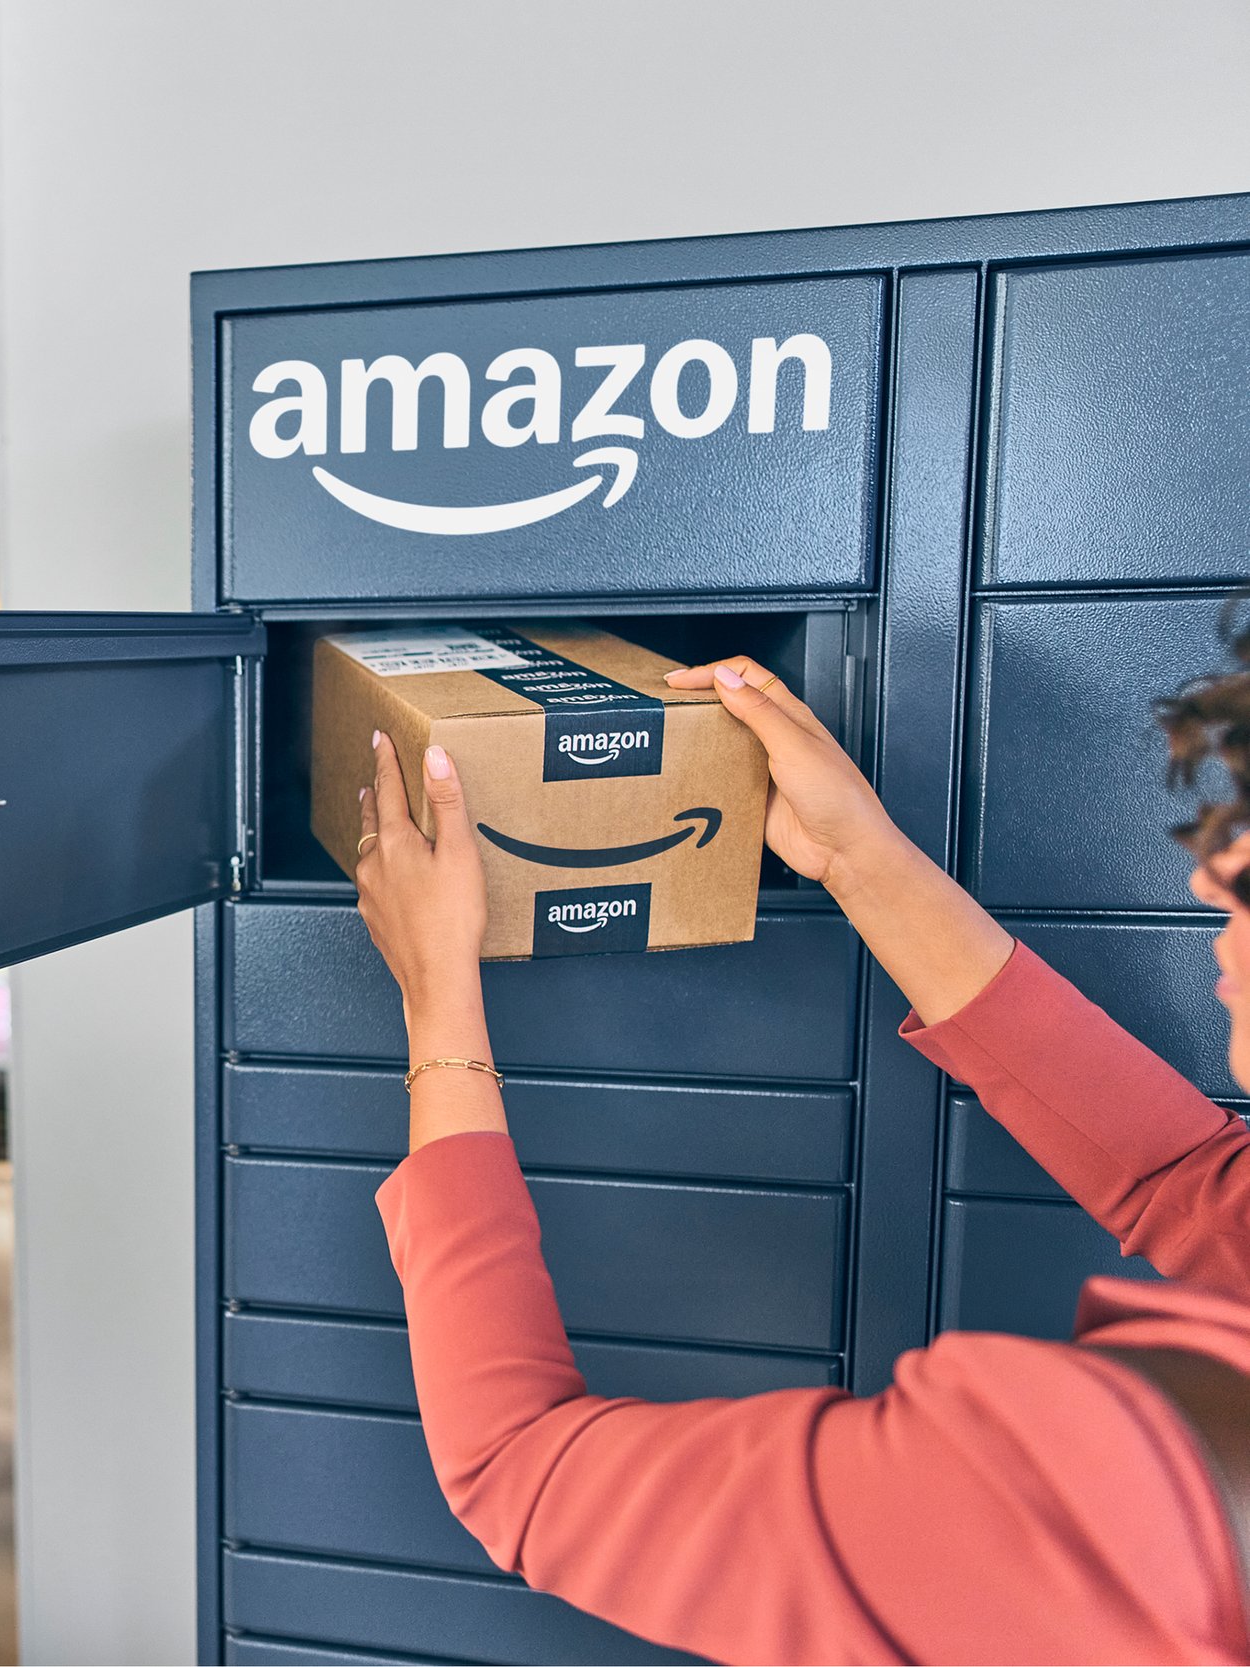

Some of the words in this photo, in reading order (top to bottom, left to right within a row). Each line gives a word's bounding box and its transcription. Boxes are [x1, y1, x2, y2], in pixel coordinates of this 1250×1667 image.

[248, 333, 833, 460] amazon
[501, 670, 587, 681] amazon
[522, 682, 612, 692] amazon
[546, 693, 639, 704] amazon
[558, 730, 650, 753] amazon
[547, 899, 637, 923] amazon
